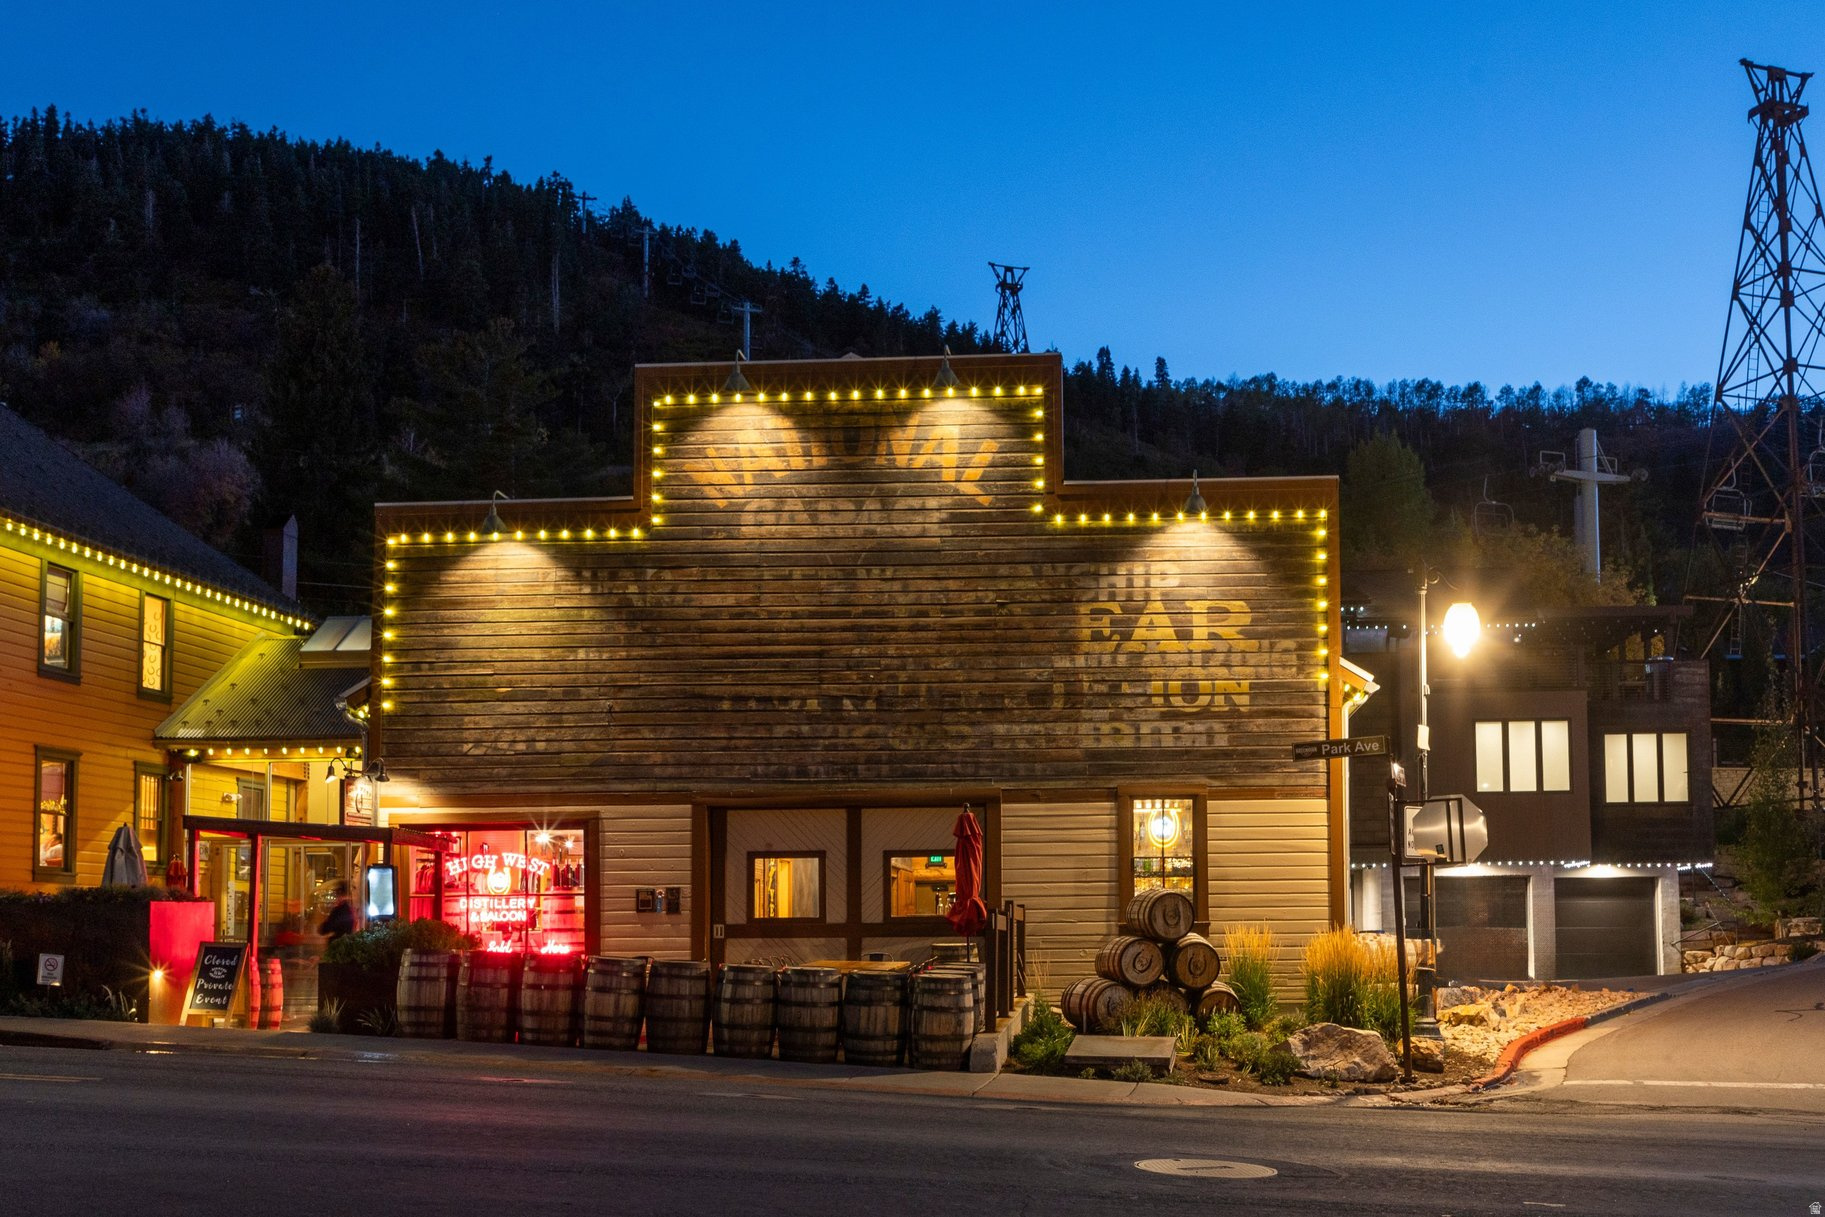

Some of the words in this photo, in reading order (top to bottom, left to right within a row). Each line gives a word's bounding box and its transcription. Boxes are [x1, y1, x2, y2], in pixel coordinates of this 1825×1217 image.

[1321, 742, 1351, 755] Park
[1354, 740, 1380, 752] Ave
[446, 854, 498, 876] HIGH
[502, 852, 550, 876] WEST
[460, 898, 536, 909] DISTILLERY
[480, 910, 527, 922] SALOON
[205, 955, 237, 965] Closed
[197, 979, 232, 990] Private
[196, 994, 226, 1004] Event
